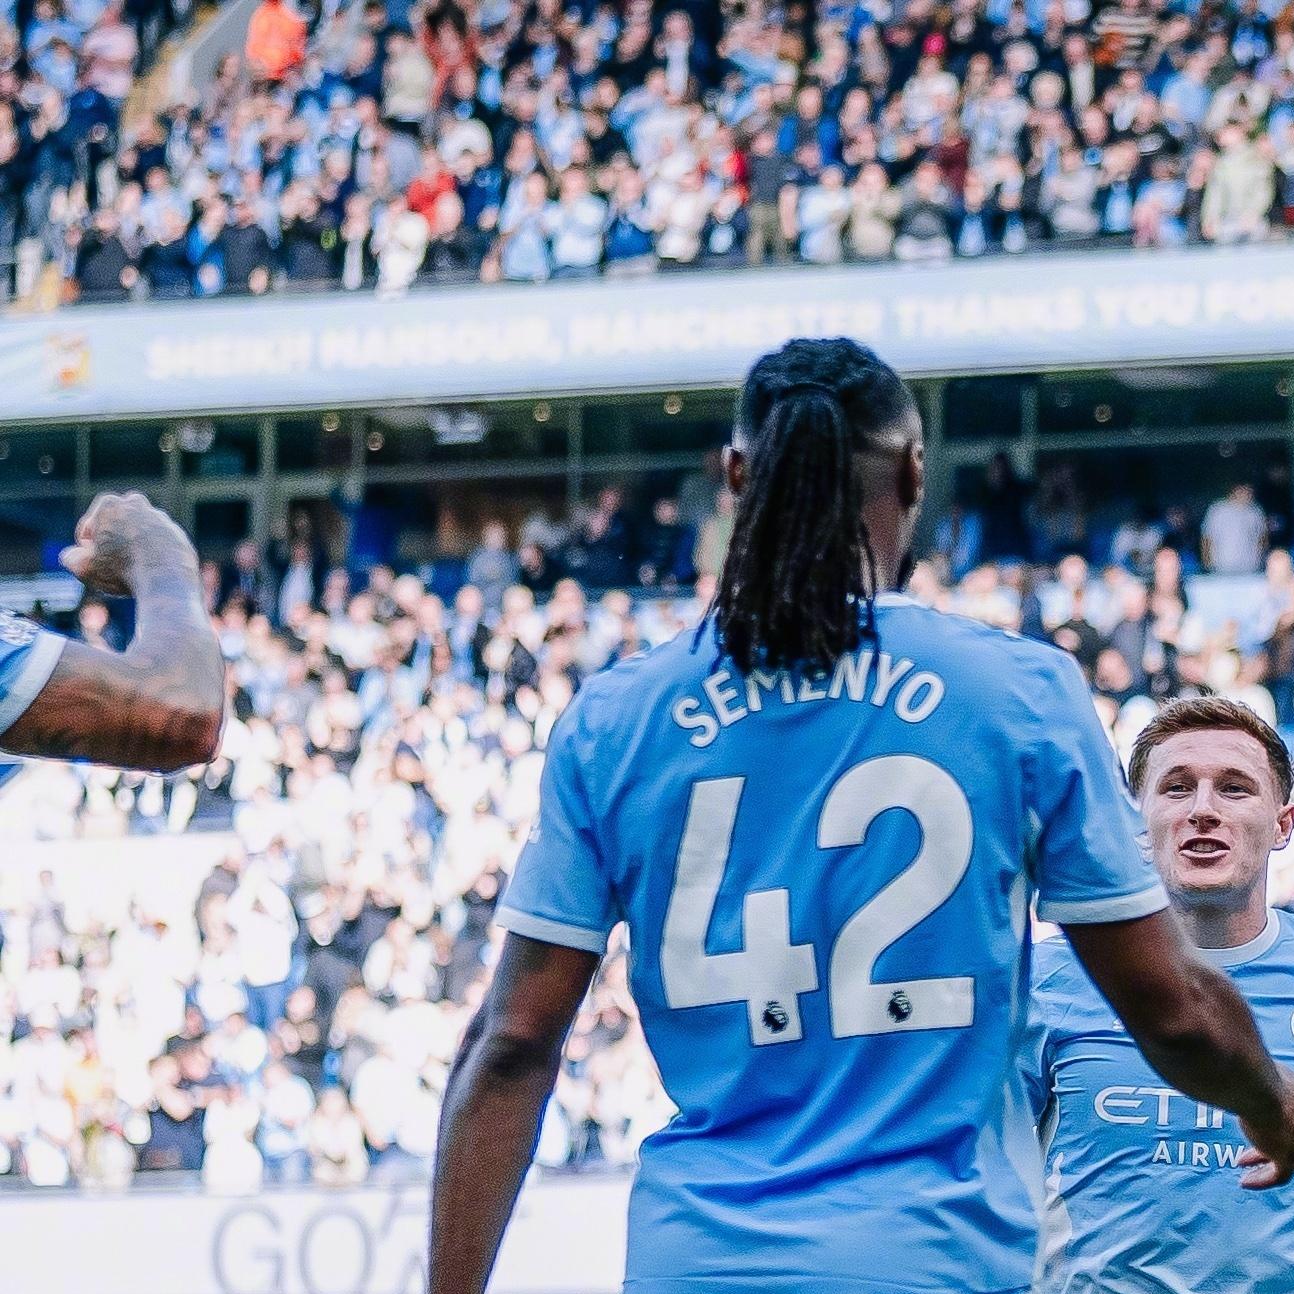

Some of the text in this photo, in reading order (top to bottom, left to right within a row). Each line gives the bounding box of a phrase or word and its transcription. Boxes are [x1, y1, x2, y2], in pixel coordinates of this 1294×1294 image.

[900, 287, 1084, 337] THANKS
[1096, 280, 1199, 331] YOU
[659, 752, 975, 1047] 42
[1151, 1139, 1246, 1169] AIRW
